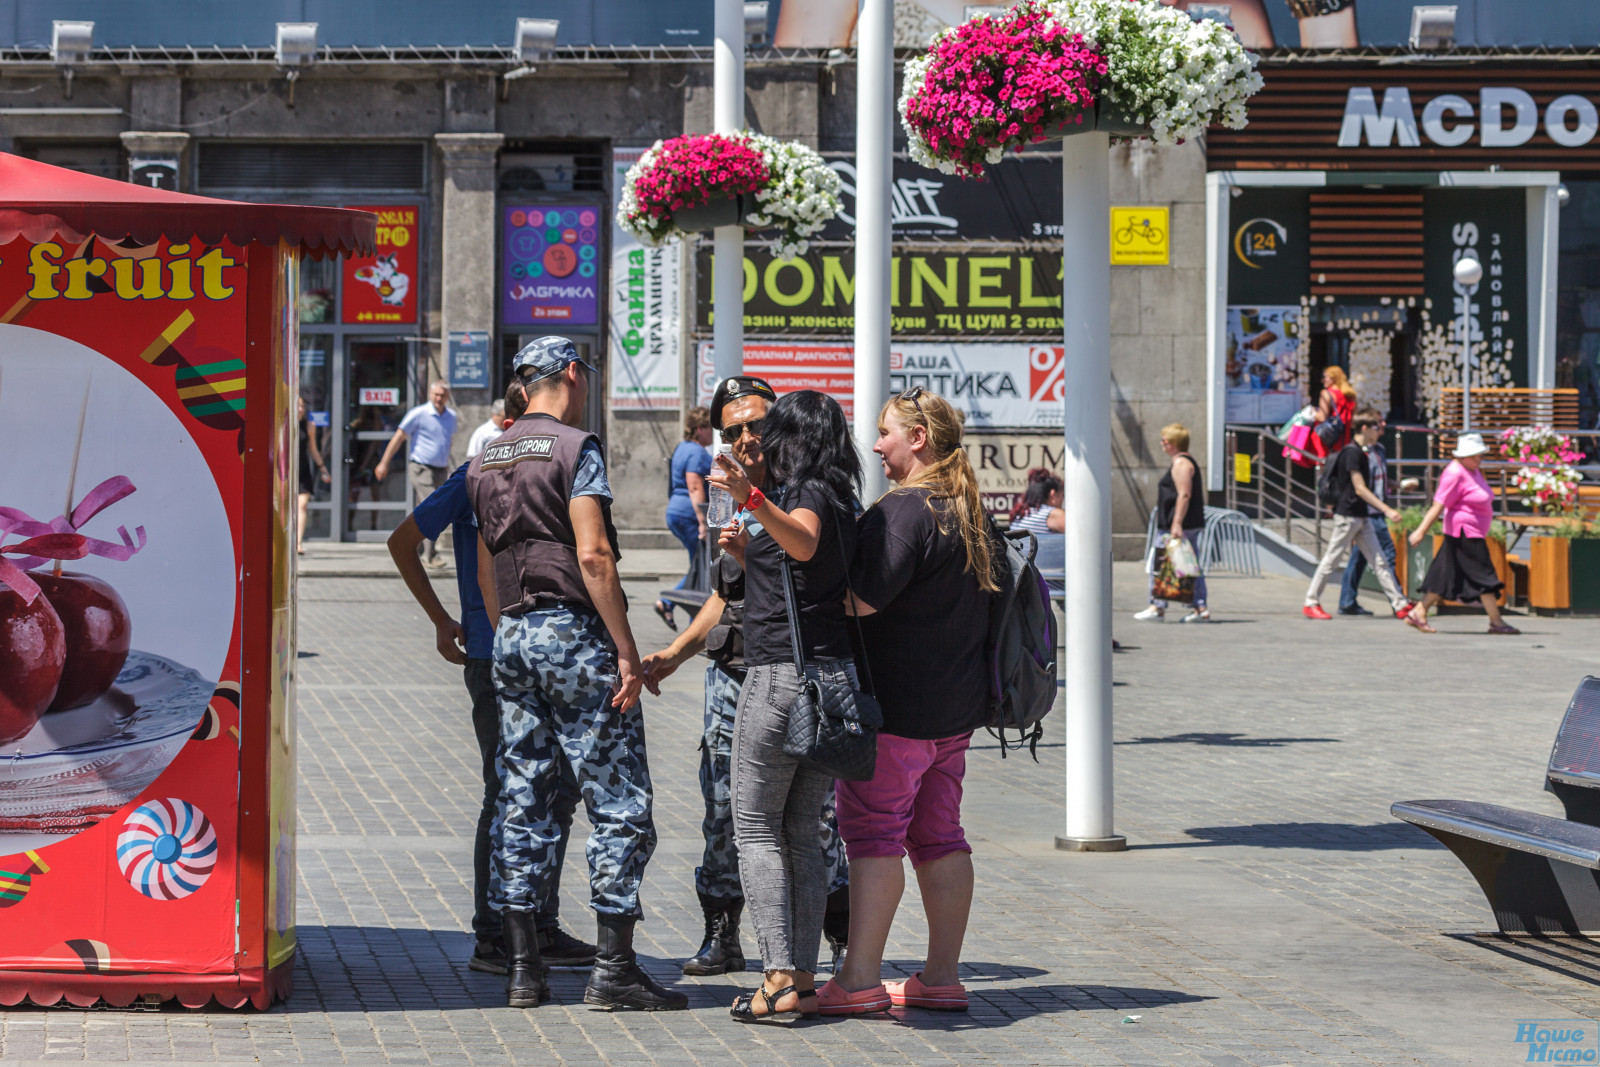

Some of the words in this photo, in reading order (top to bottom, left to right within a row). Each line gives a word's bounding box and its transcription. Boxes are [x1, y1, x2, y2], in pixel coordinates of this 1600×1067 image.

[1337, 87, 1599, 147] McDo
[1032, 223, 1044, 235] 3
[1253, 233, 1276, 249] 24
[26, 242, 236, 300] fruit
[790, 315, 855, 328] женско
[936, 314, 962, 331] ТЦ
[966, 314, 1007, 331] ЦУМ
[1010, 314, 1022, 328] 2
[963, 443, 1065, 471] RUM
